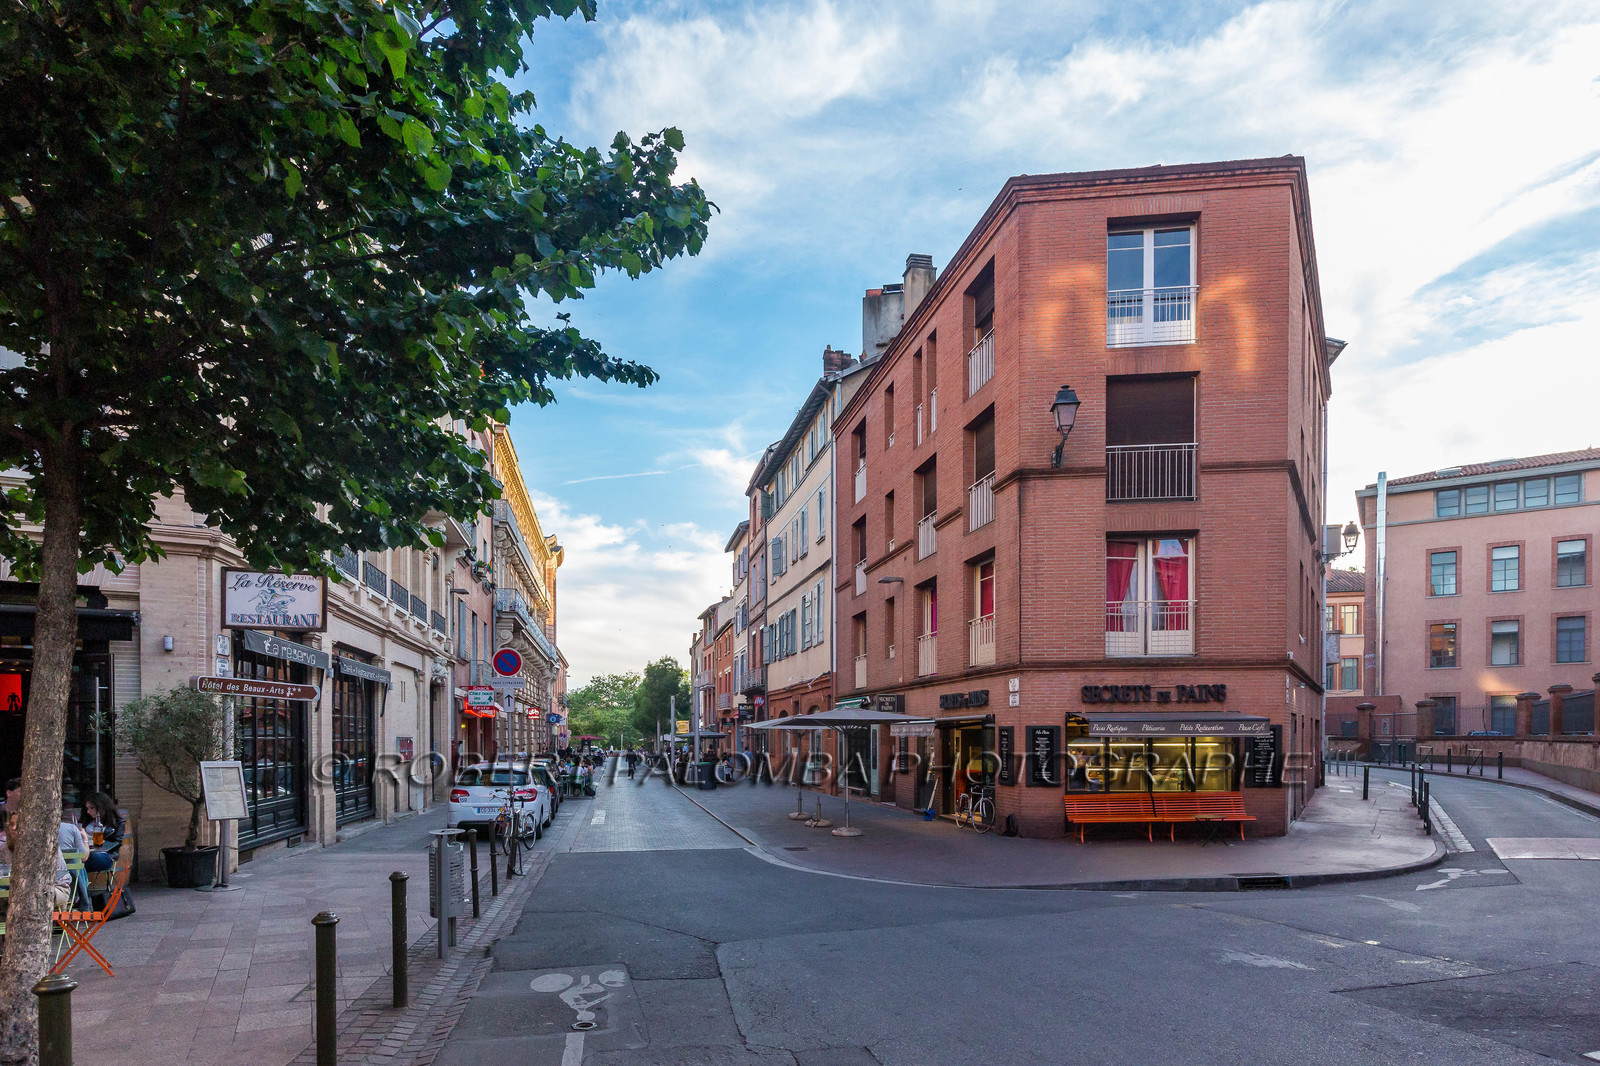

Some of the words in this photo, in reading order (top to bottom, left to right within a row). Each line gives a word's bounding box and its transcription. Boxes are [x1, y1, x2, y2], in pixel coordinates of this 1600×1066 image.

[228, 573, 252, 591] La
[231, 613, 319, 626] RESTAURANT
[281, 644, 316, 665] réserve
[201, 678, 223, 690] Hôtel
[226, 682, 240, 691] des
[243, 683, 285, 695] Beaux-Arts
[1081, 685, 1151, 703] SECRETS
[1157, 691, 1171, 703] DE
[1176, 684, 1227, 703] PAINS
